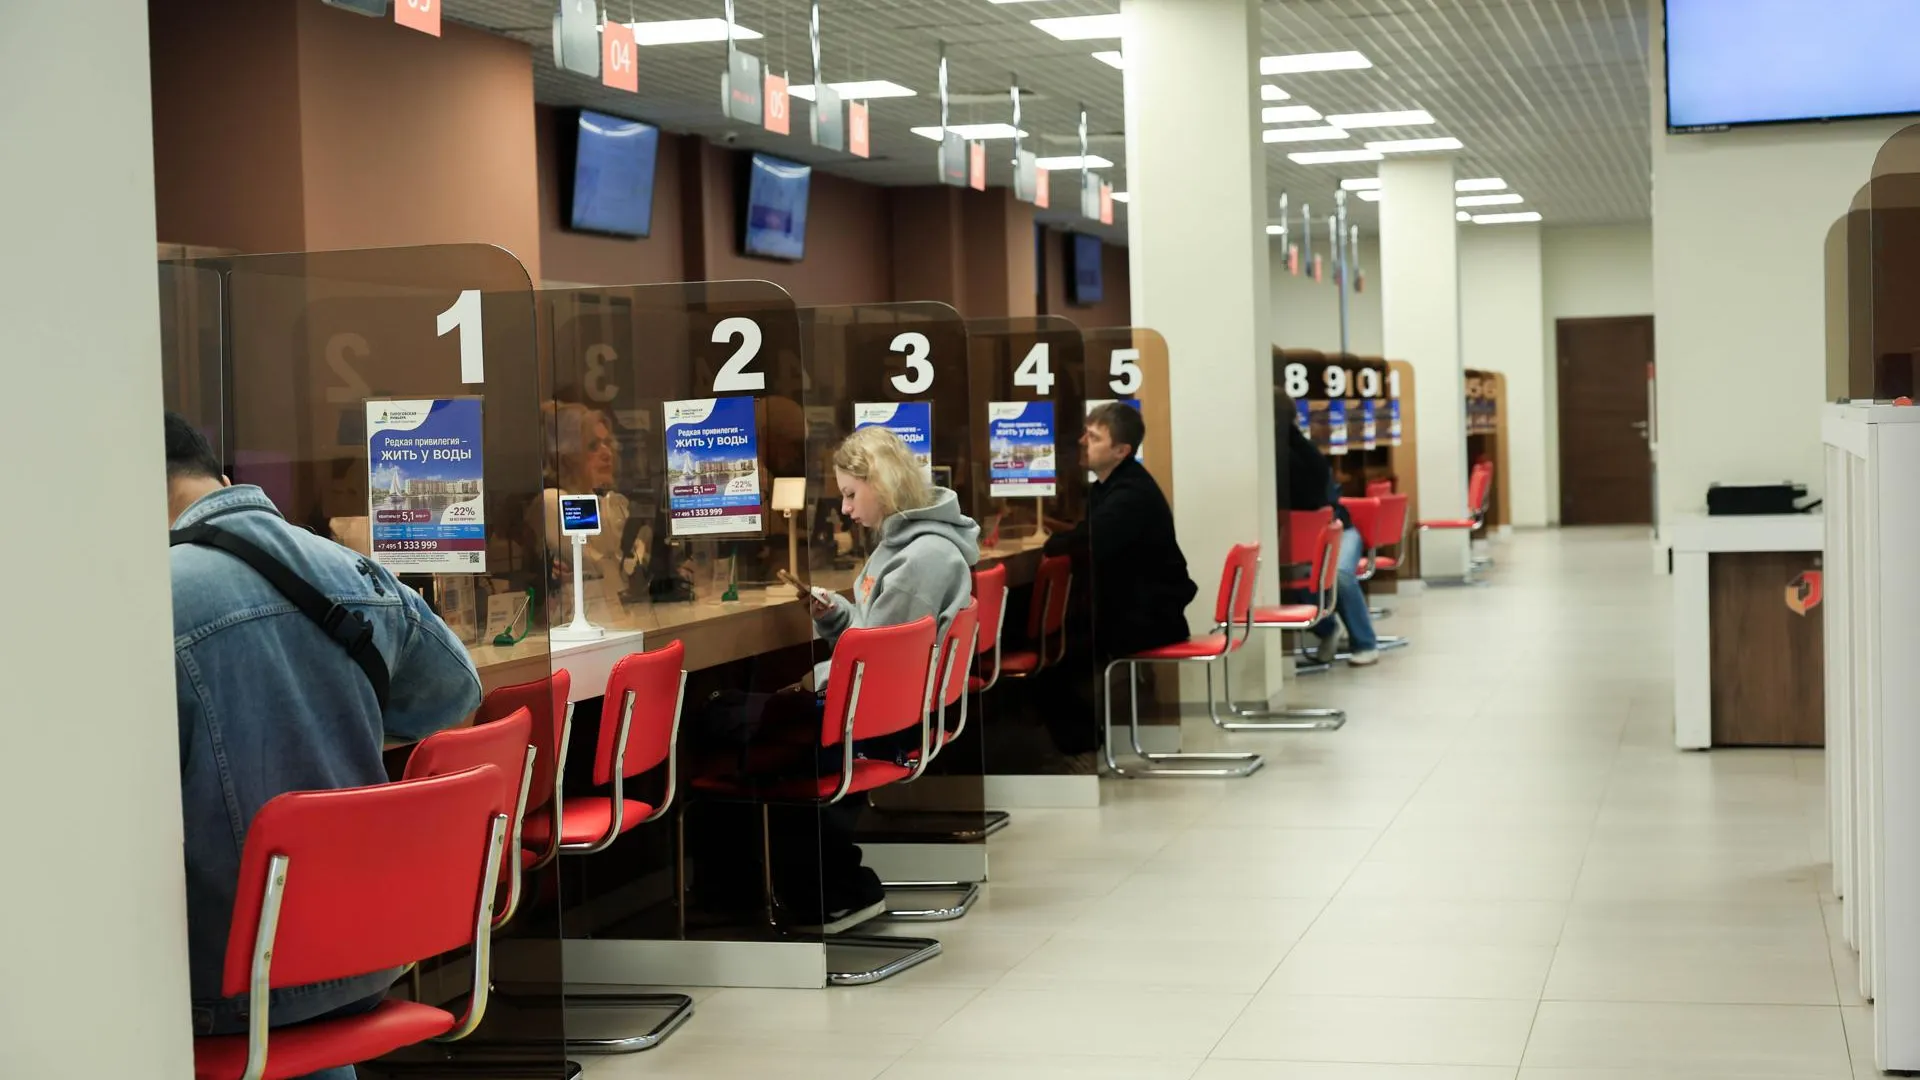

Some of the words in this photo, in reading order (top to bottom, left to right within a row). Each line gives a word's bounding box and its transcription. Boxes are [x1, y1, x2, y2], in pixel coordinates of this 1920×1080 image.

[611, 40, 630, 73] 04
[770, 90, 785, 119] 05
[437, 289, 484, 384] 1
[711, 316, 766, 392] 2
[889, 331, 935, 394] 3
[1013, 342, 1055, 396] 4
[1108, 348, 1143, 395] 5
[1284, 362, 1309, 398] 8
[1322, 364, 1346, 398] 9
[384, 437, 413, 447] Редкая
[414, 437, 460, 447] привилегия
[402, 511, 414, 521] 5,1
[449, 507, 476, 516] -22%
[404, 540, 420, 549] 333
[421, 540, 438, 549] 999
